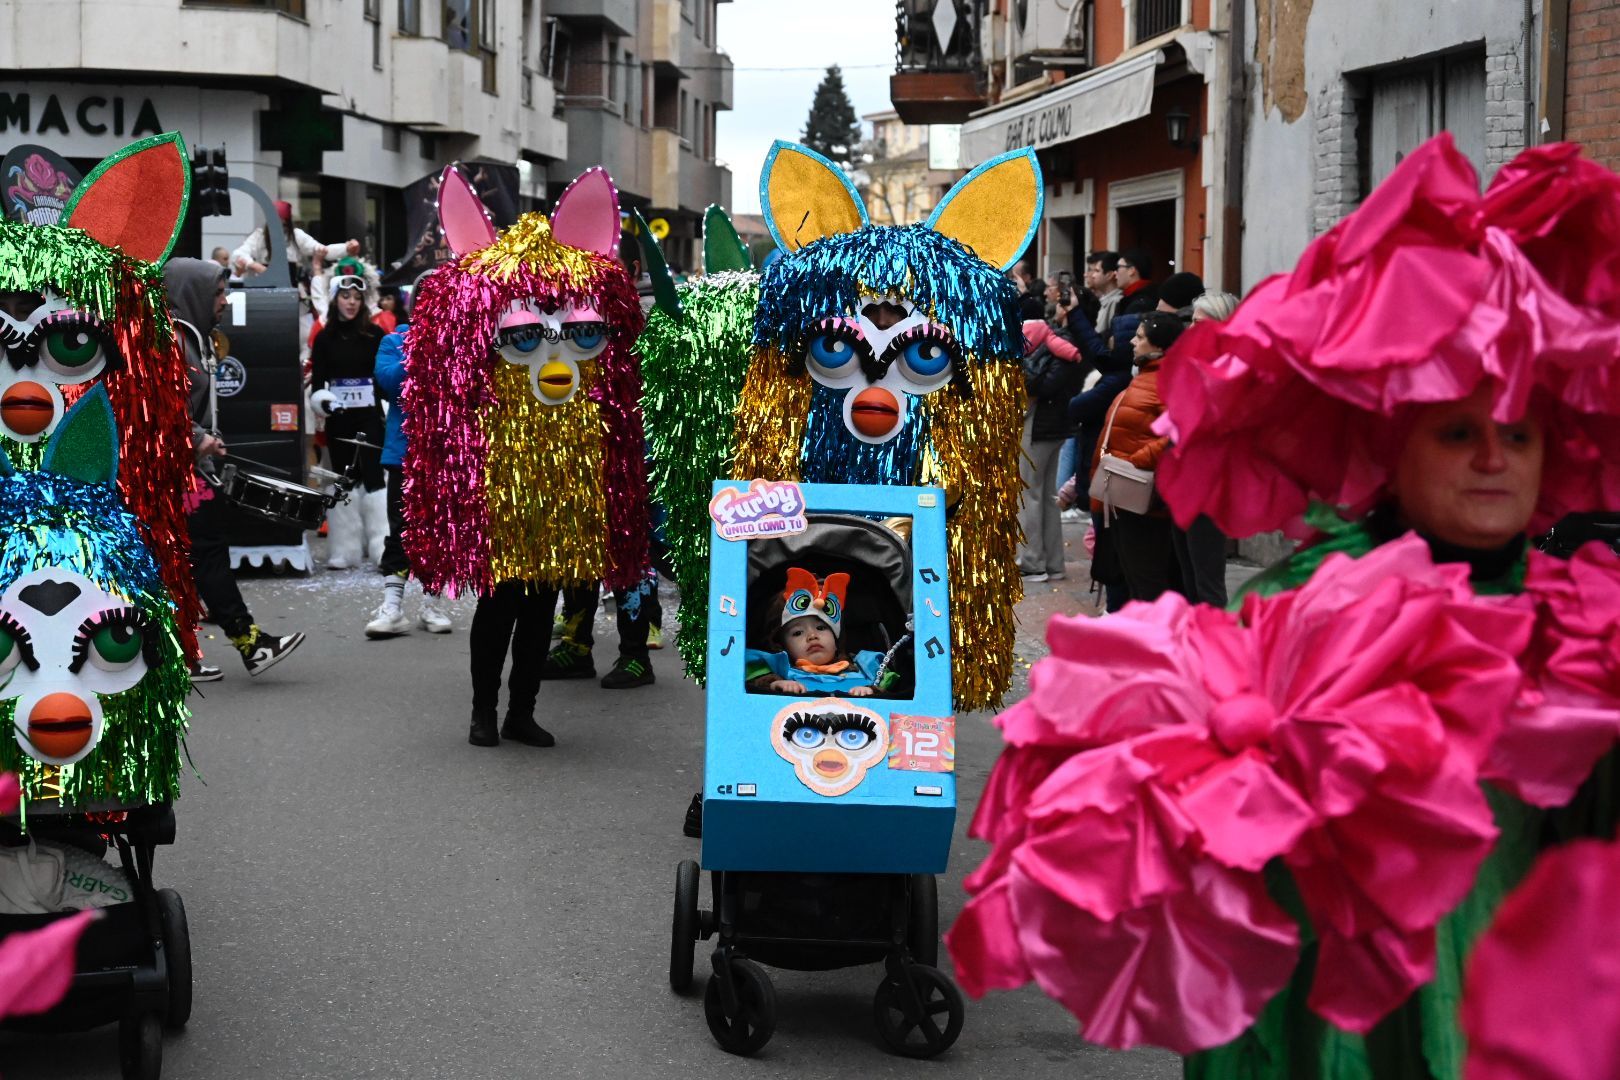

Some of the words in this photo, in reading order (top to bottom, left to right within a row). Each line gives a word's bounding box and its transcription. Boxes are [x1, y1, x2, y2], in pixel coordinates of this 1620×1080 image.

[0, 92, 163, 137] MACIA
[1027, 116, 1036, 147] EL
[1039, 104, 1072, 143] COLMO
[226, 291, 246, 326] 1
[341, 391, 362, 401] 711
[276, 411, 292, 424] 13
[758, 519, 786, 532] COMO
[901, 730, 939, 757] 12
